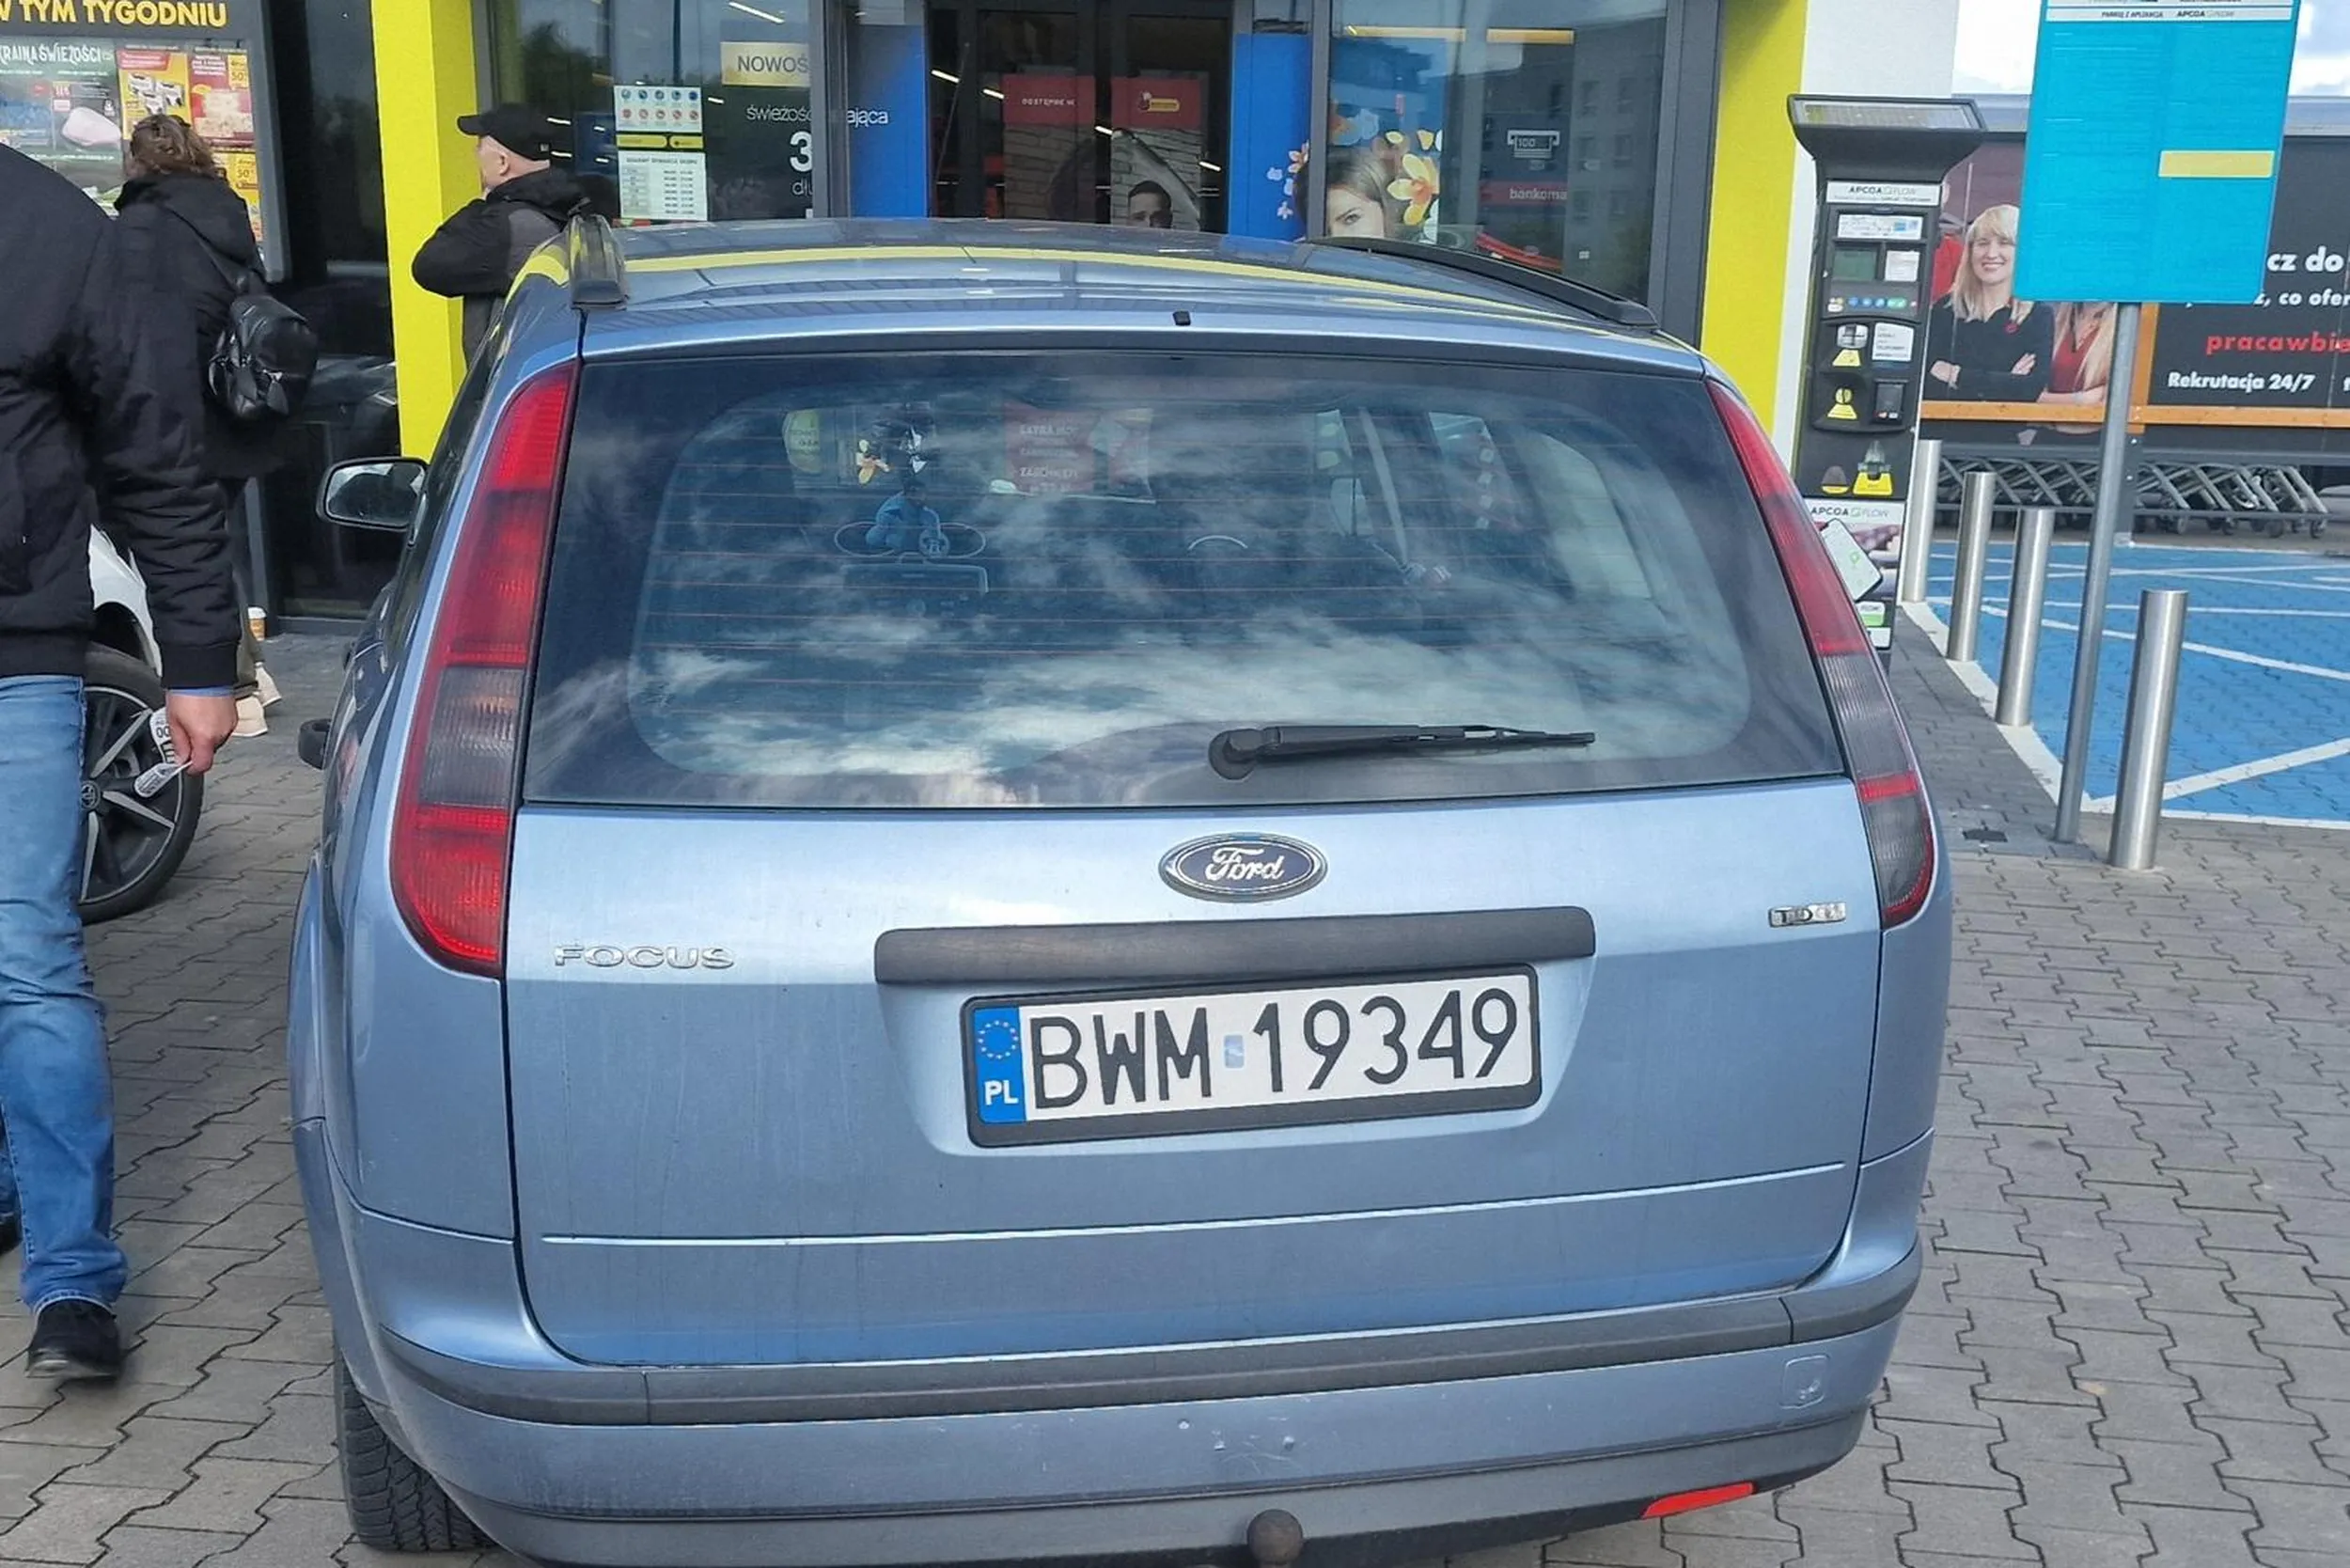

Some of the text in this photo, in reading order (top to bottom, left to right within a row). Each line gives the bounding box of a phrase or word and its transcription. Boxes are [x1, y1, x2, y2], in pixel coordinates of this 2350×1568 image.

[21, 0, 76, 23] TYM
[83, 0, 227, 26] TYGODNIU
[738, 55, 809, 73] NOWOŚ
[1510, 188, 1567, 200] bankoma
[1849, 186, 1882, 195] APCOA
[2305, 246, 2344, 273] do
[2279, 292, 2302, 306] co
[2168, 371, 2315, 393] Rekrutacja 24/7
[1810, 507, 1849, 515] APCOA
[1205, 847, 1285, 882] Ford
[554, 945, 735, 969] FOCUS
[1029, 988, 1517, 1110] BWM 19349
[984, 1080, 1019, 1106] PL
